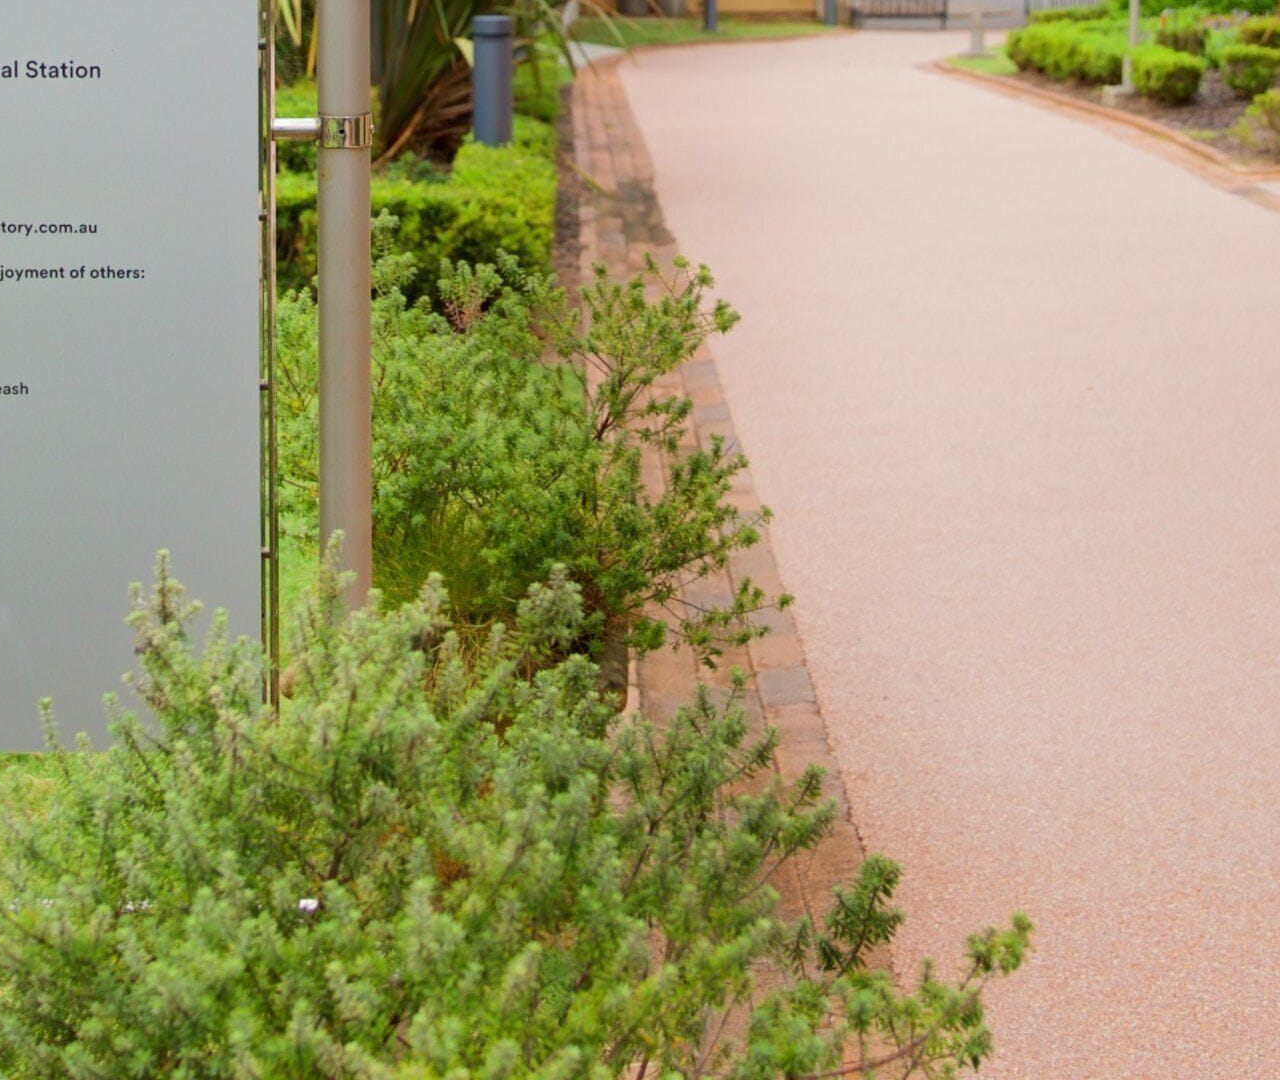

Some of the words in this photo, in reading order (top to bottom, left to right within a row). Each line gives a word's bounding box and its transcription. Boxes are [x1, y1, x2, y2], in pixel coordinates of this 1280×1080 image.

[25, 59, 101, 79] Station
[69, 264, 86, 279] of
[89, 264, 145, 279] others:
